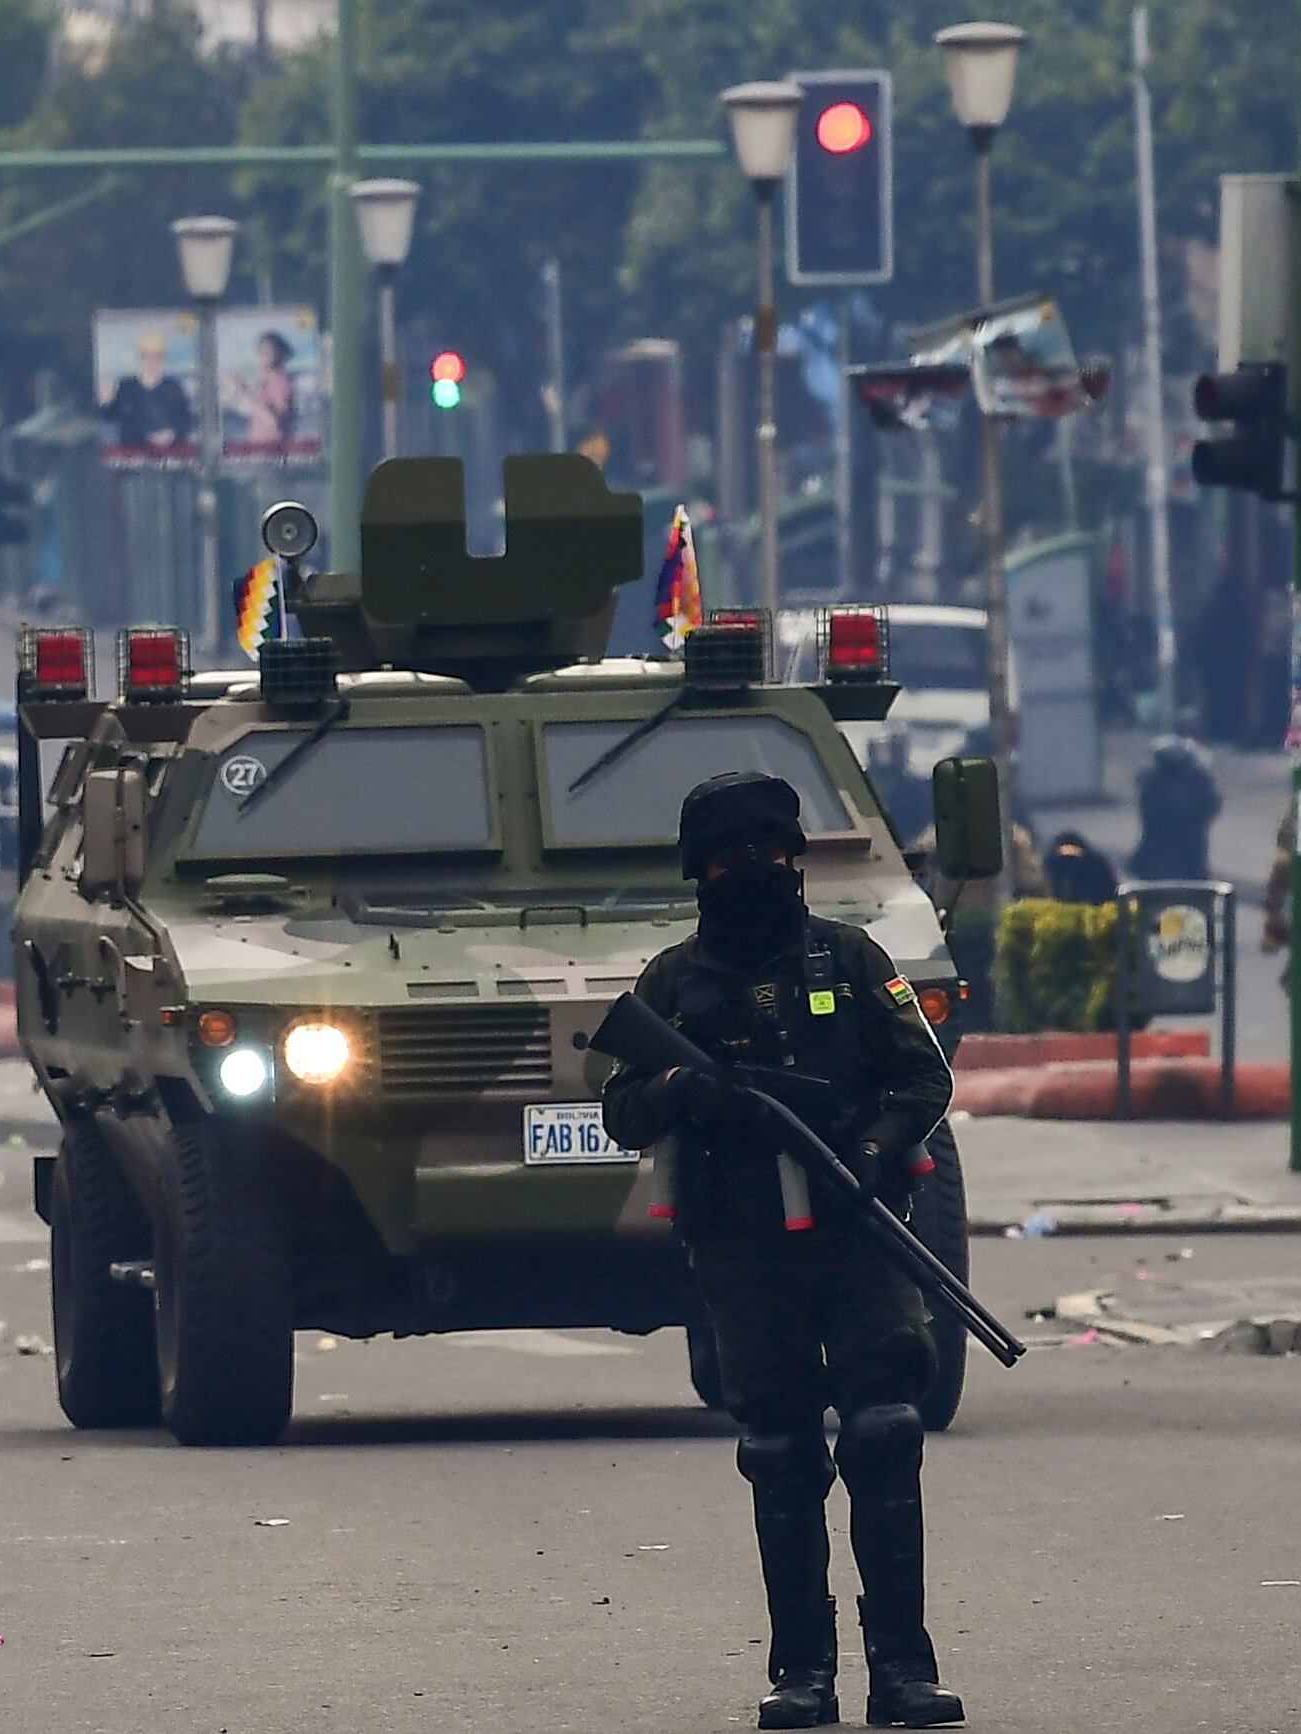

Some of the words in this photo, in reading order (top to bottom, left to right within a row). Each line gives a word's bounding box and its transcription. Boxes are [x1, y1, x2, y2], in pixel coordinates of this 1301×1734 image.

[229, 763, 258, 786] 27
[556, 1111, 600, 1120] BOLIVIA
[532, 1123, 572, 1153] FAB
